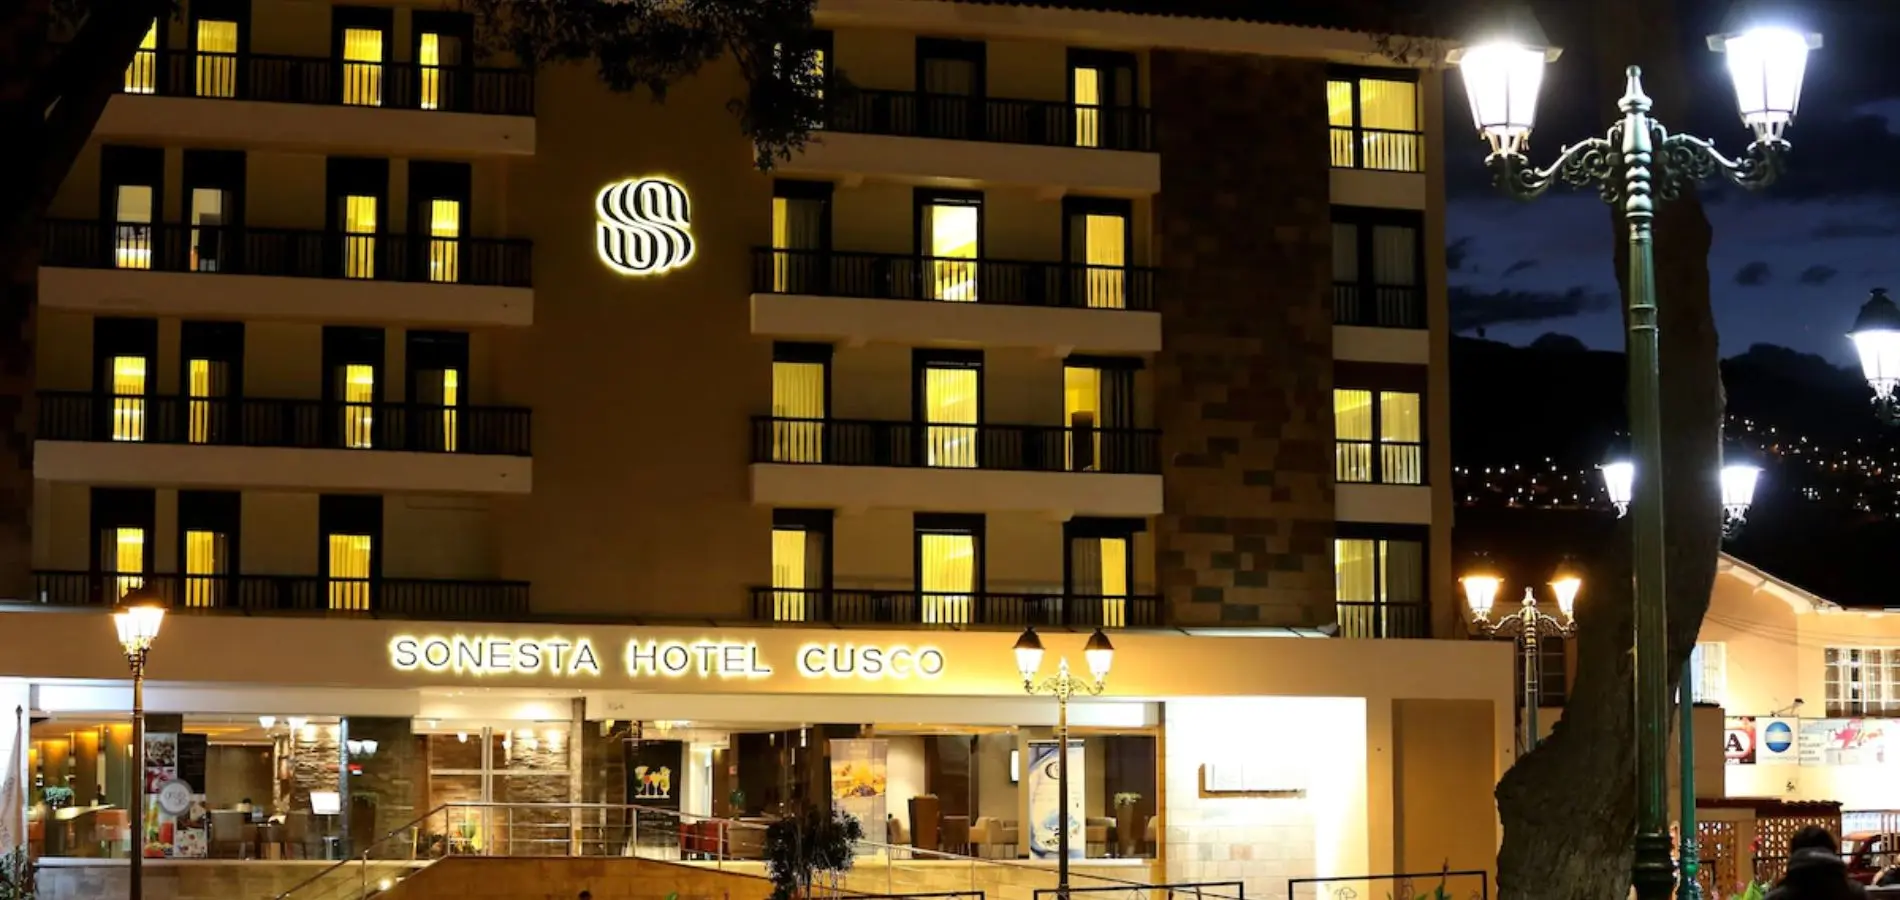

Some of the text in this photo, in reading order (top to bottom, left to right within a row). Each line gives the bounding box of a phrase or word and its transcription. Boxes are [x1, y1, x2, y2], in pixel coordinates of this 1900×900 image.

[393, 637, 944, 676] SONESTA HOTEL CUSCO
